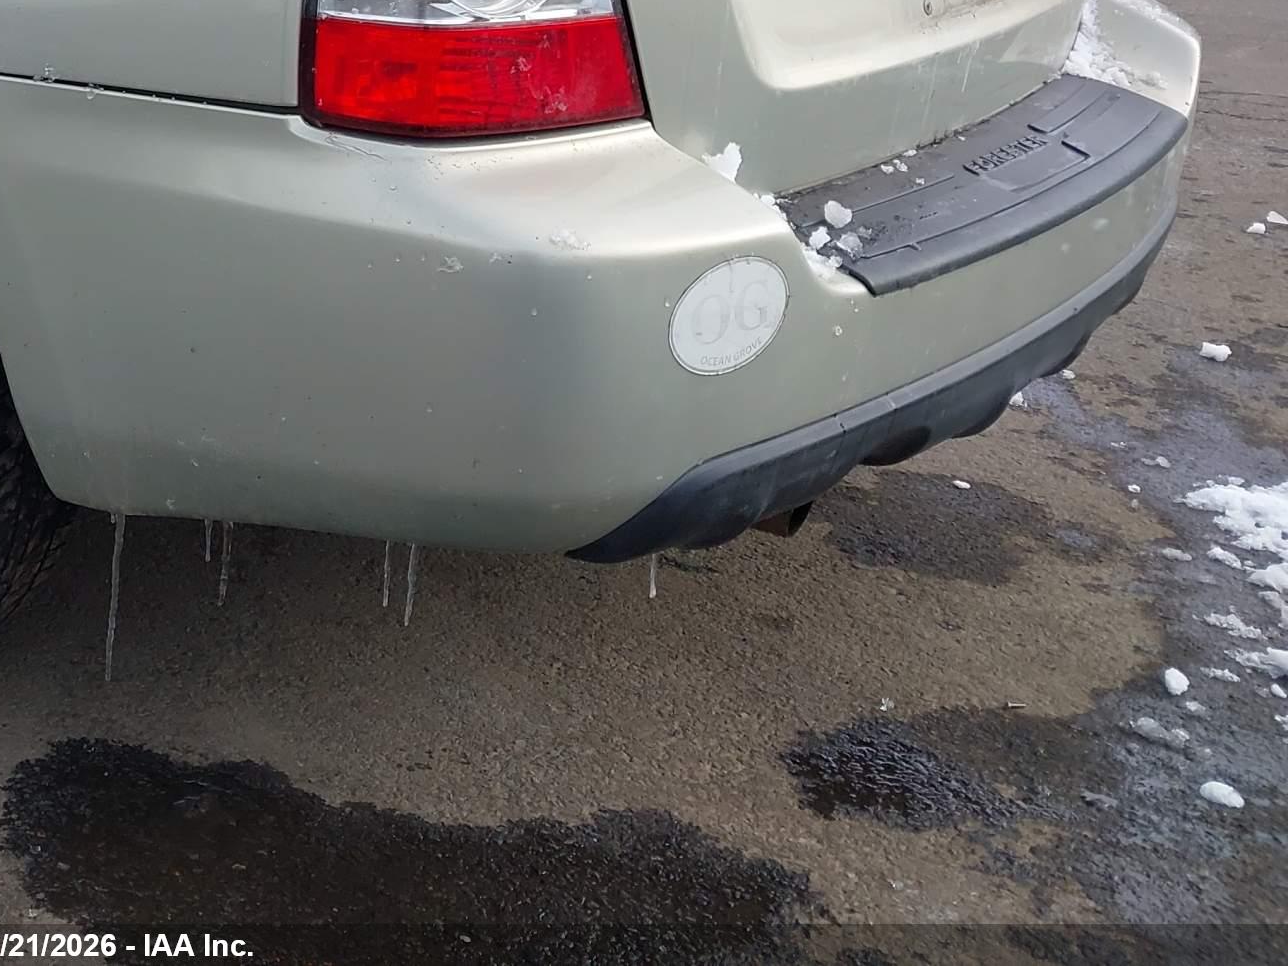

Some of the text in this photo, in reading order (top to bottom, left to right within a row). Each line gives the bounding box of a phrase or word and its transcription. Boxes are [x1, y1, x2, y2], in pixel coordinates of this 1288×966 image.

[691, 280, 770, 345] OG
[699, 336, 765, 367] OCEAN GROVE
